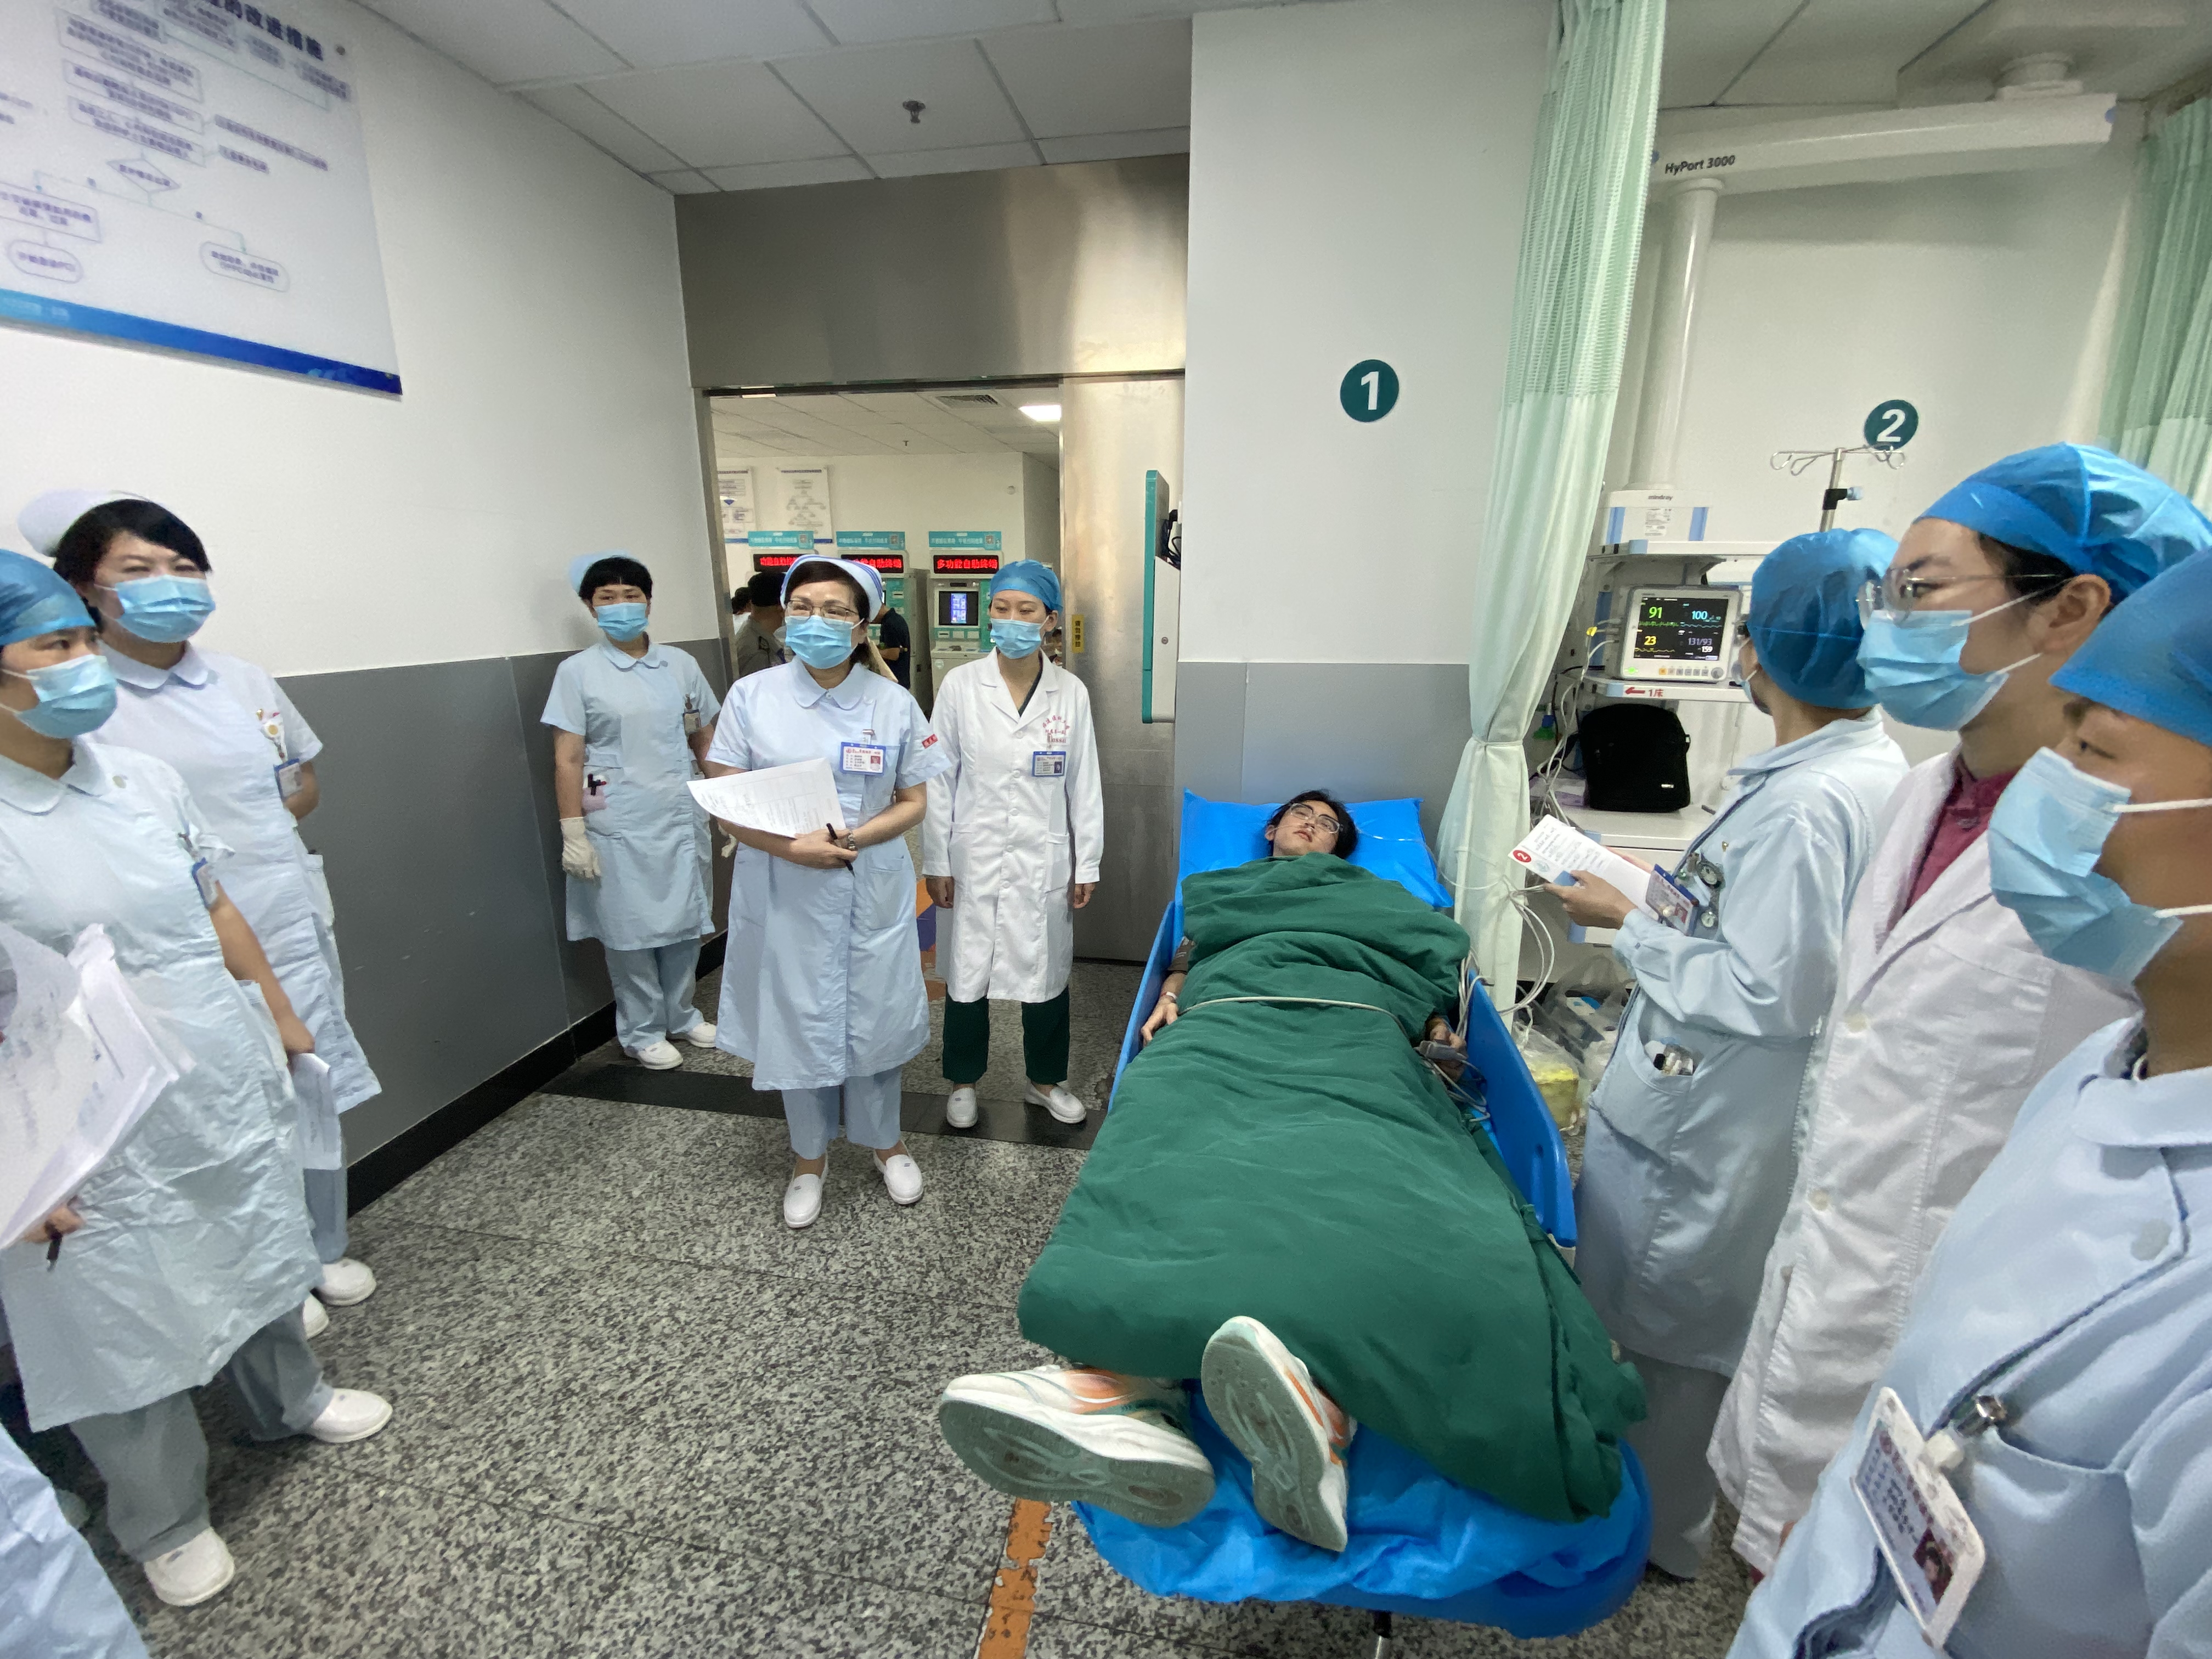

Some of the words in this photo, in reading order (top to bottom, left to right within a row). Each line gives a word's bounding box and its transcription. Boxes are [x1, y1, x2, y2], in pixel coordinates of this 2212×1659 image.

[1664, 159, 1705, 176] HyPort
[1707, 155, 1736, 168] 3000
[1361, 371, 1379, 410] 1
[1876, 409, 1906, 442] 2
[937, 558, 998, 569] 多功能自助终端
[1649, 606, 1663, 619] 91
[1691, 610, 1708, 620] 100
[1644, 635, 1657, 646] 23
[1688, 637, 1713, 646] 131/93
[1649, 689, 1664, 697] 1床
[1517, 852, 1528, 861] 2
